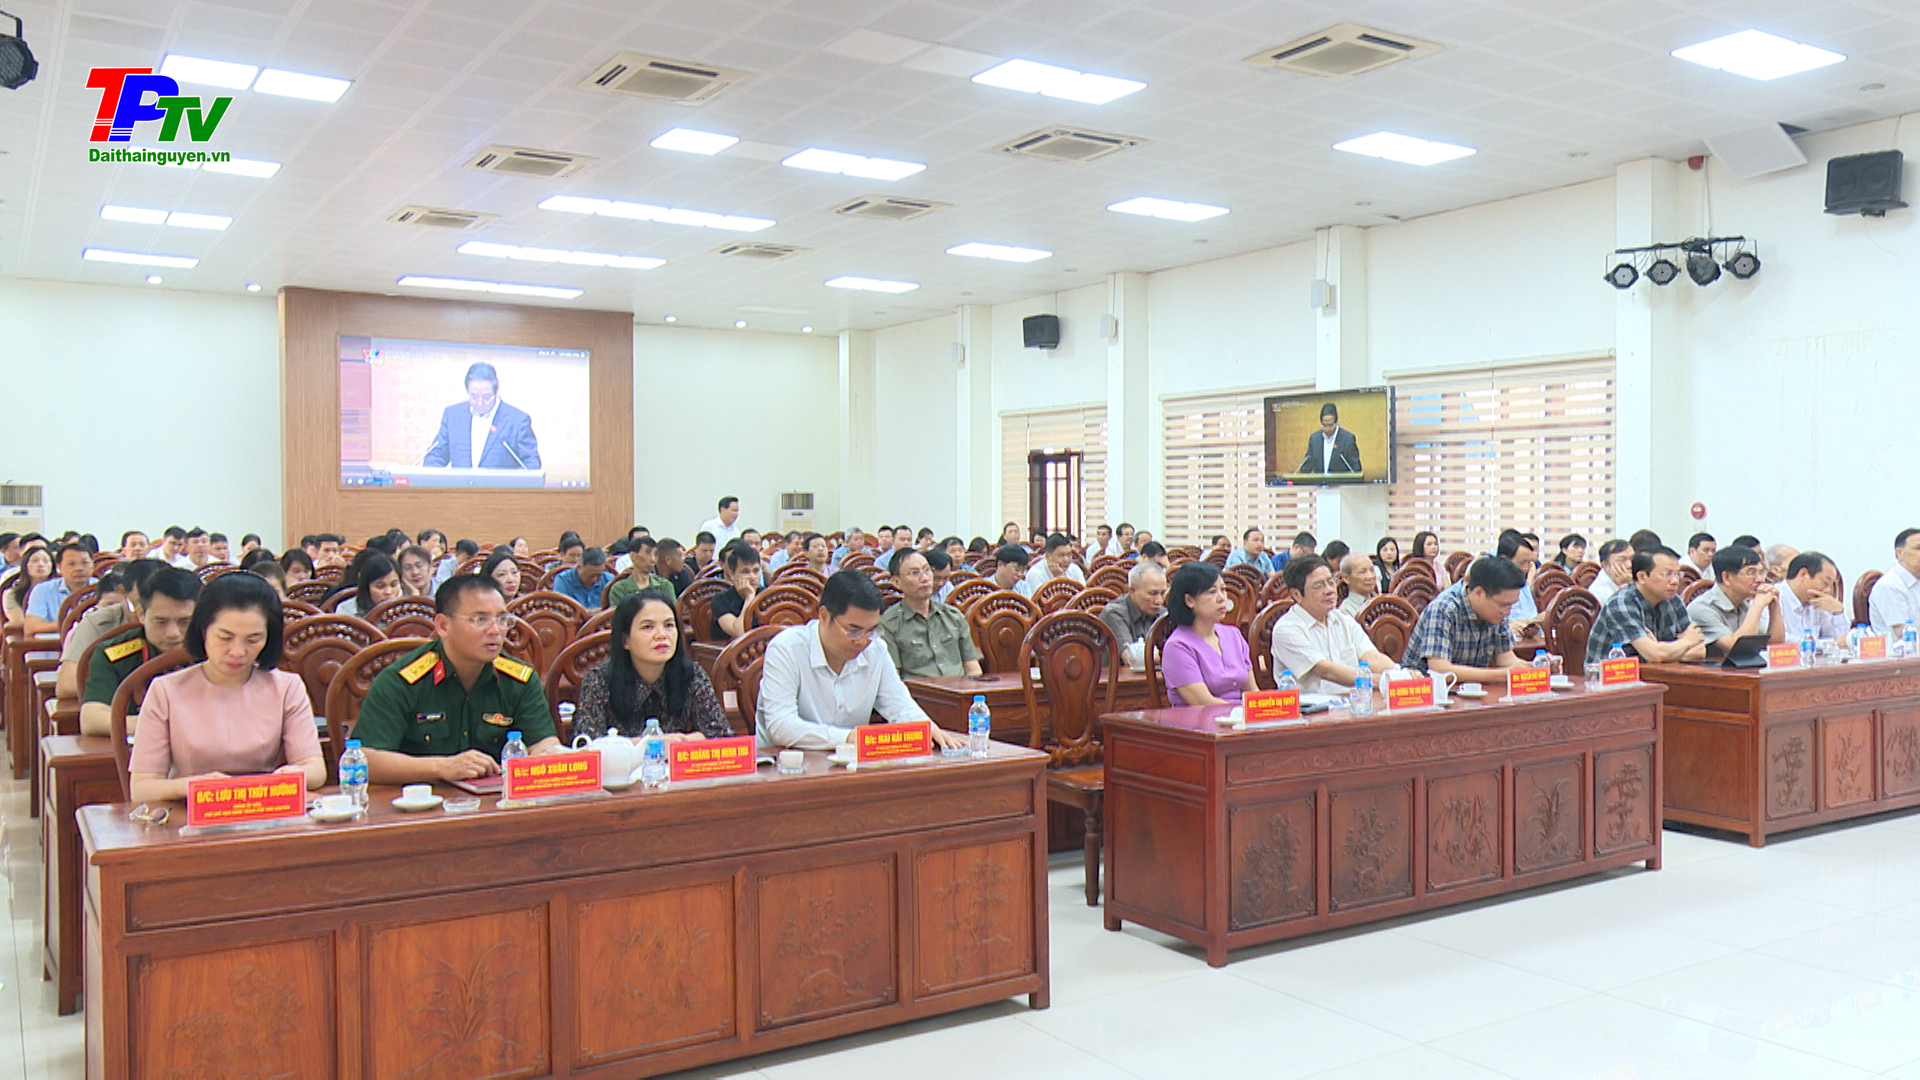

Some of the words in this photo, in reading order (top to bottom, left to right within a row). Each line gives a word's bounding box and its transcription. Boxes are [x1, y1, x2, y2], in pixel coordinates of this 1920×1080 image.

[548, 762, 567, 774] XUÂN
[569, 761, 588, 772] LONG
[233, 788, 247, 801] THỊ
